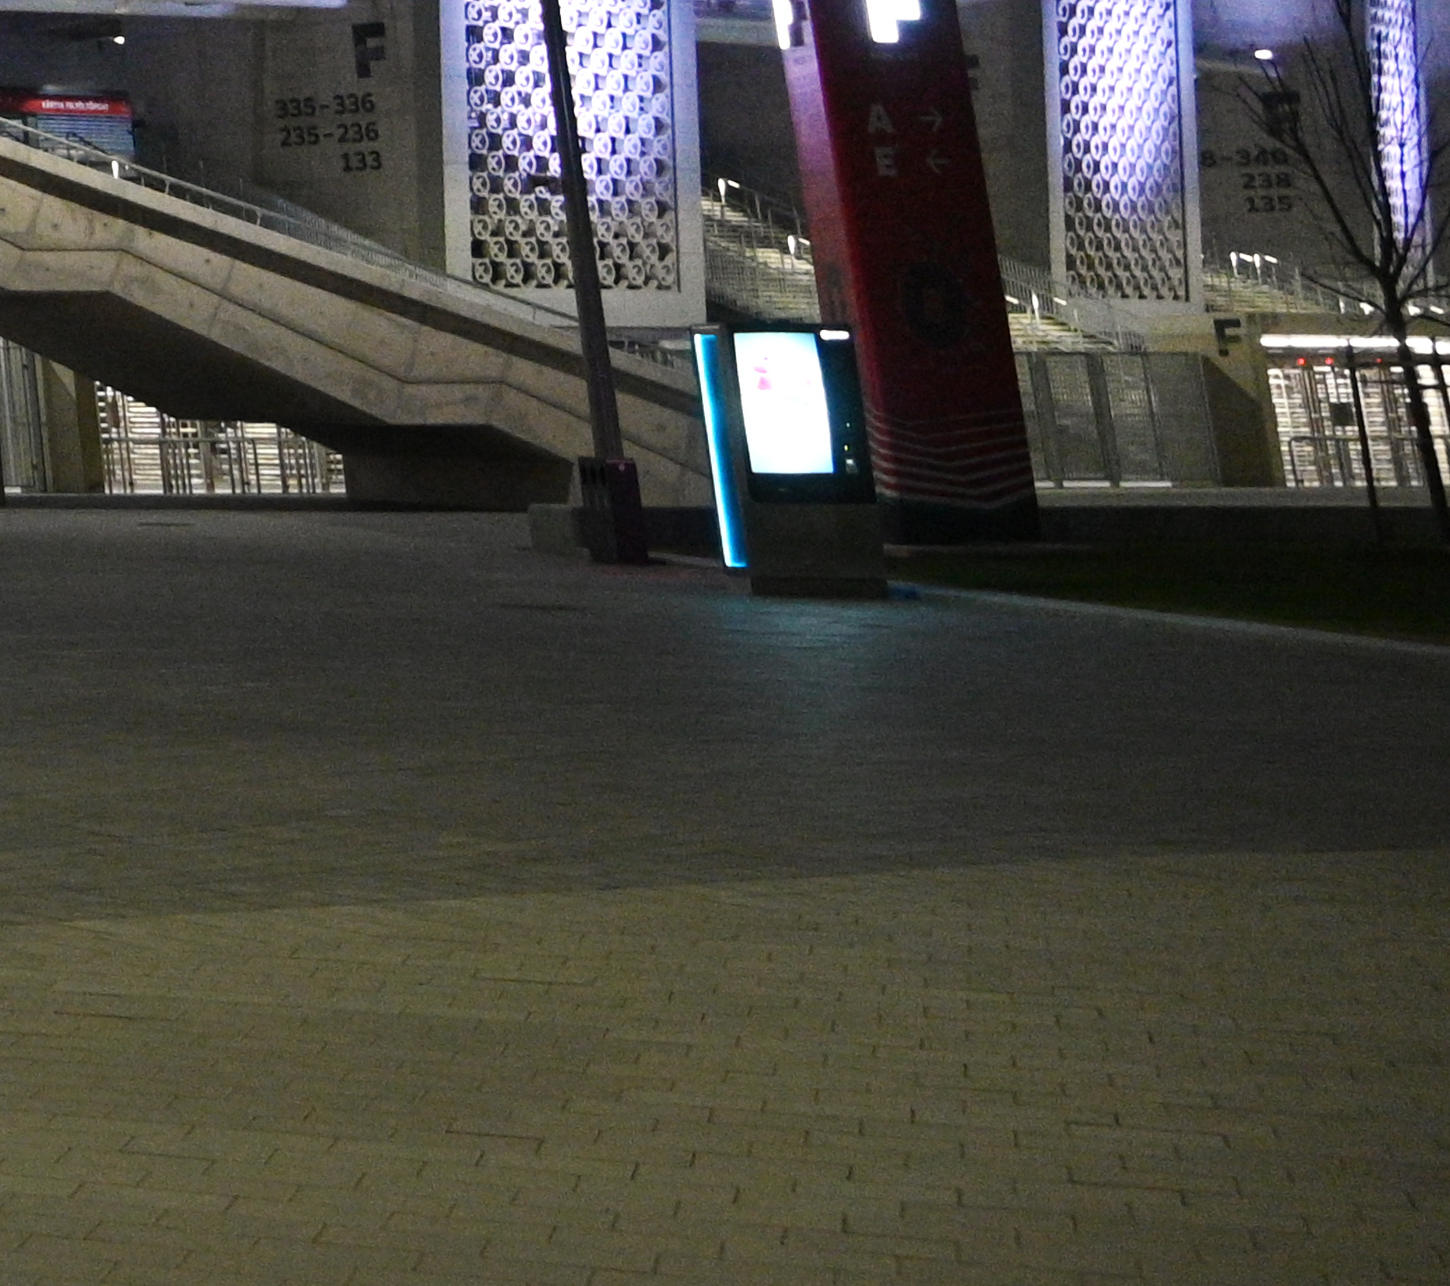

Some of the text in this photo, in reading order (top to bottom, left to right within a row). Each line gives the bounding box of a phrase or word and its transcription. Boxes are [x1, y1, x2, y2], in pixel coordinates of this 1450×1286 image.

[351, 22, 386, 79] F
[275, 93, 376, 120] 335-336
[867, 103, 895, 134] A
[280, 122, 380, 148] 235-236
[341, 150, 382, 172] 133
[874, 145, 900, 178] E
[1239, 171, 1292, 190] 238
[1244, 195, 1293, 213] 135
[1214, 318, 1242, 358] F
